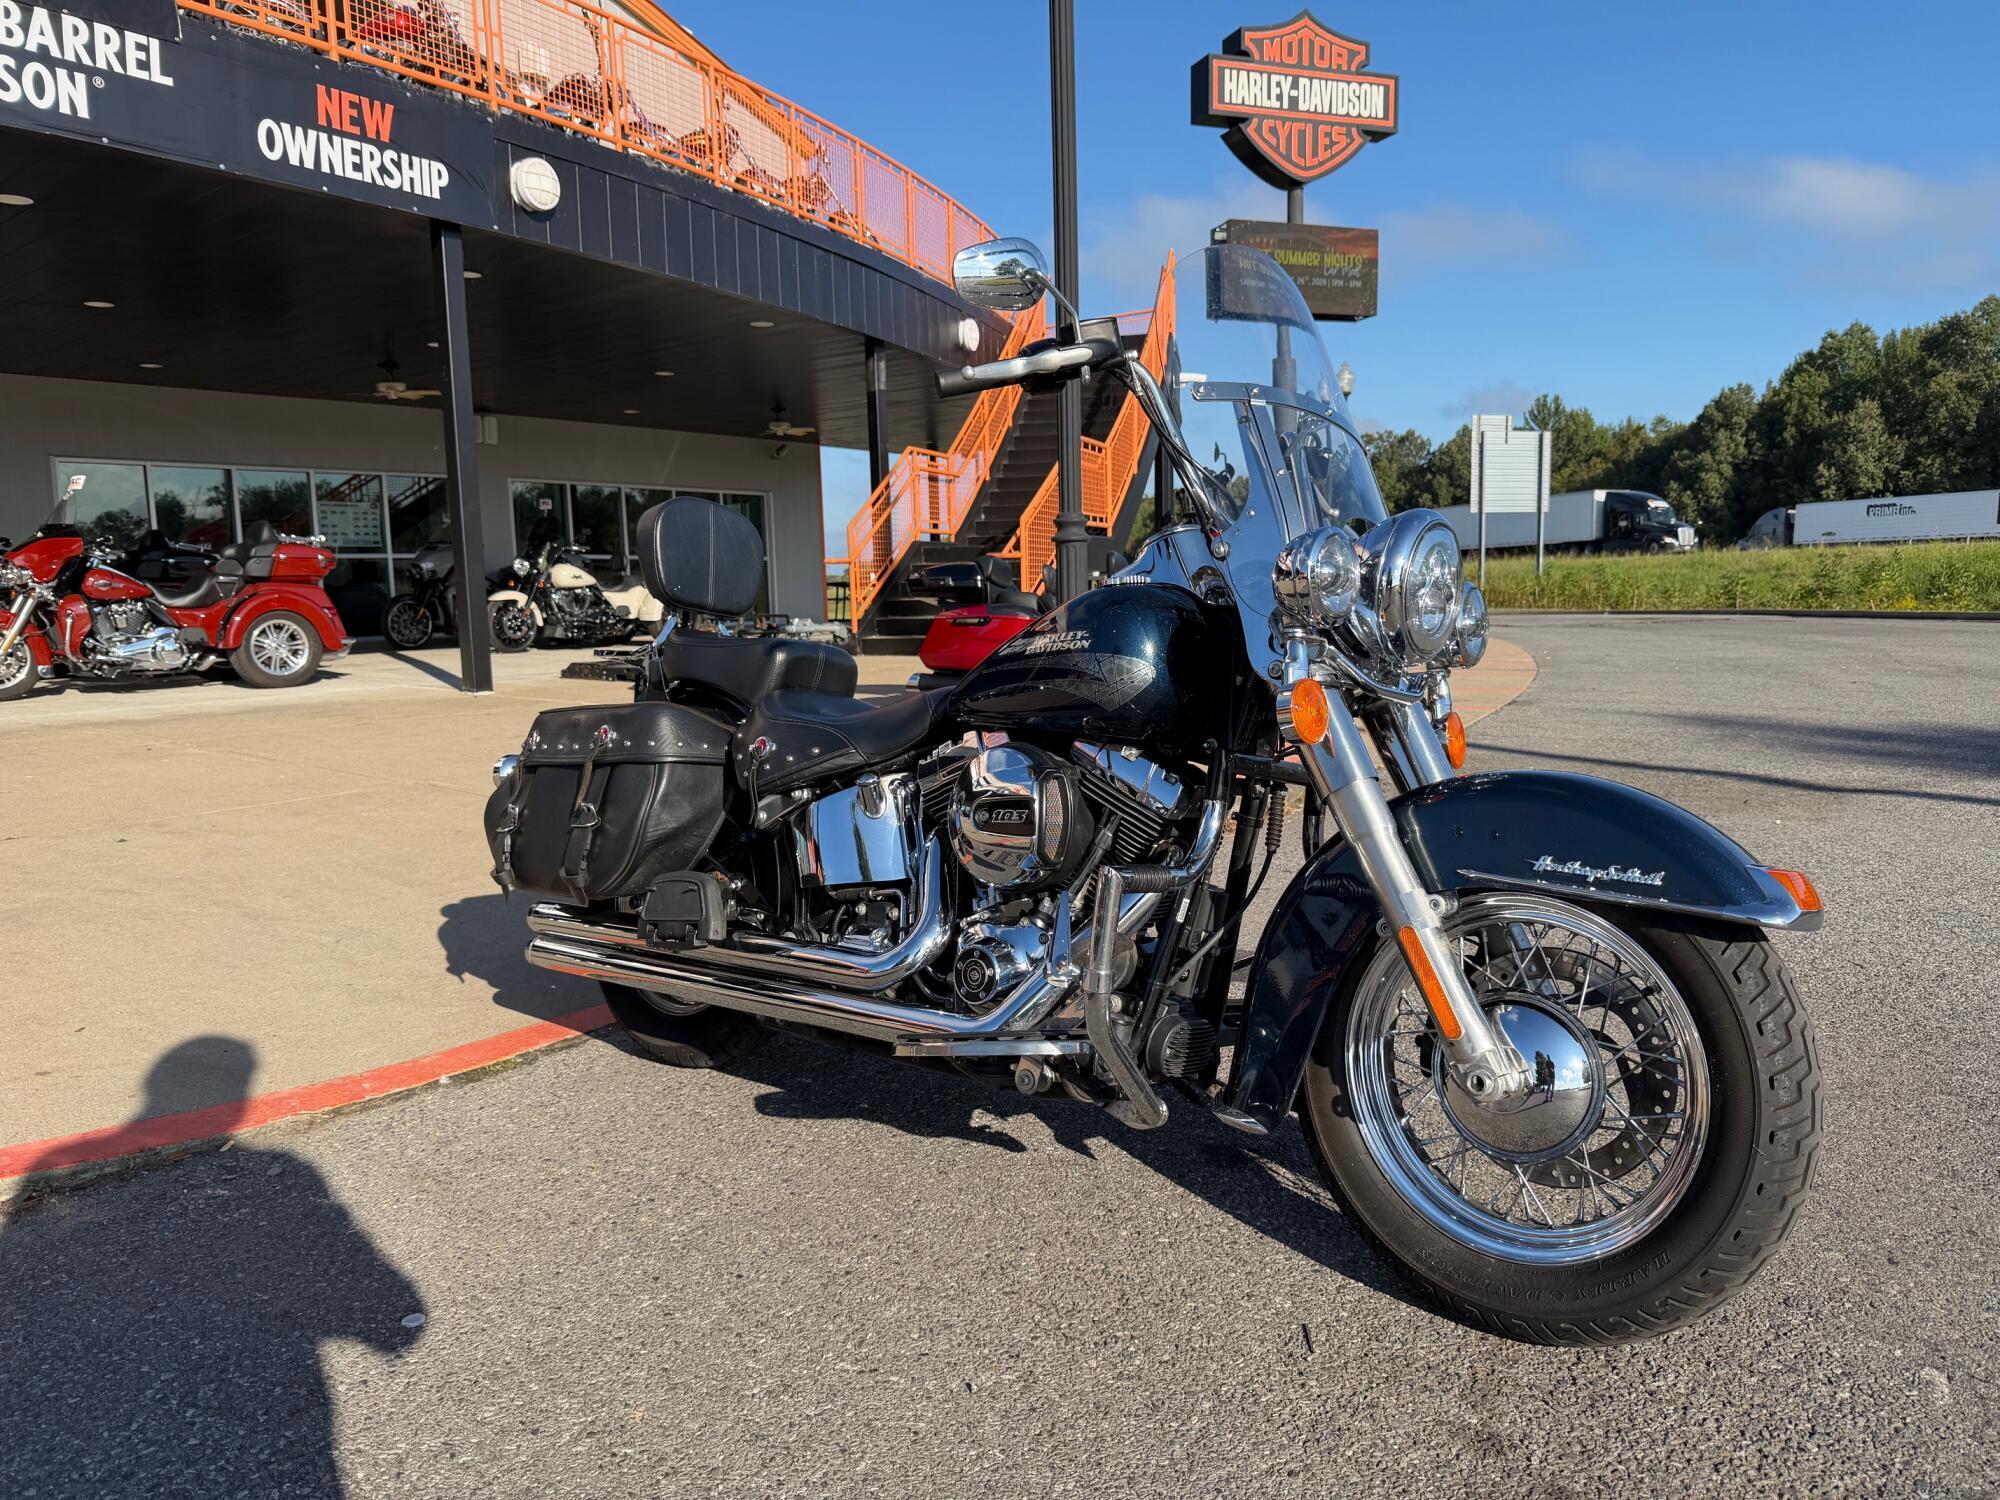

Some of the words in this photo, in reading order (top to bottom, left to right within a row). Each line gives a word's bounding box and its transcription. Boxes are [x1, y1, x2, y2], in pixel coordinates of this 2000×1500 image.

[0, 0, 173, 86] BARREL
[1263, 27, 1348, 71] MOTOR
[316, 83, 394, 142] NEW
[1224, 68, 1385, 119] HARLEY-DAVIDSON
[257, 118, 449, 200] OWNERSHIP
[1262, 119, 1347, 167] CYCLES
[1274, 250, 1320, 267] SUMMER
[1323, 250, 1363, 269] NIGHTS
[1024, 640, 1092, 655] DAVIDSON
[991, 809, 1029, 823] 103
[1574, 1249, 1672, 1299] HARLEY
